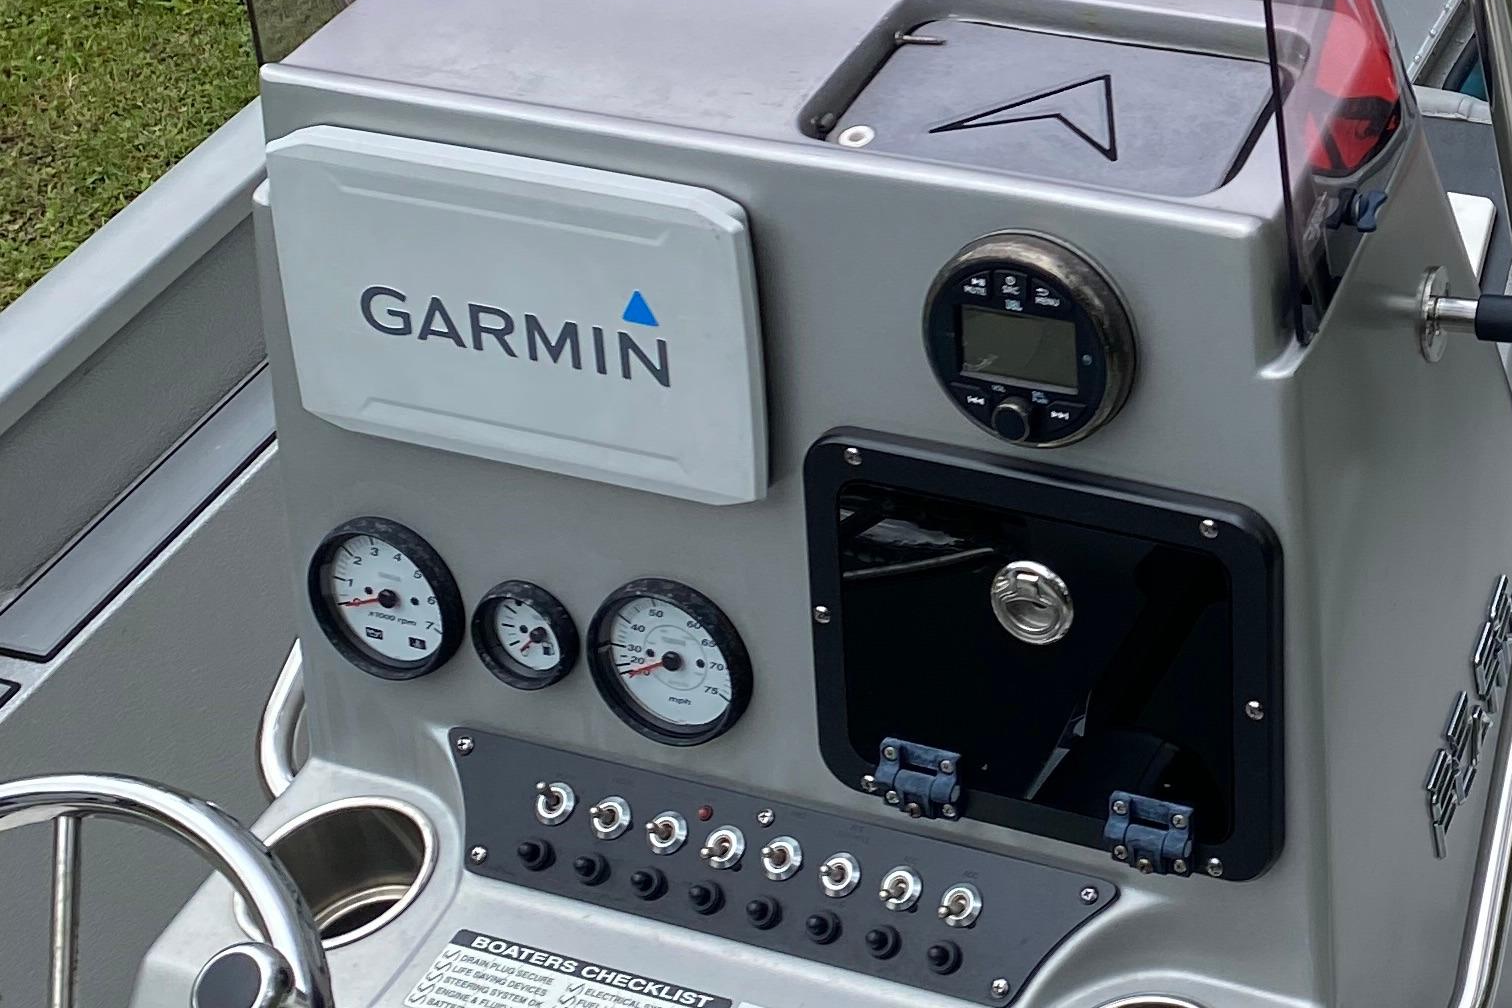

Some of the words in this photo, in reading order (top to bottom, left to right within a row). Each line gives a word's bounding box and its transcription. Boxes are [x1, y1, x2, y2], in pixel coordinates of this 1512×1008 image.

[359, 285, 673, 388] GARMIN
[370, 547, 379, 557] 3
[353, 556, 362, 565] 2
[393, 553, 402, 562] 4
[427, 596, 436, 605] 6
[648, 609, 664, 618] 50
[425, 621, 434, 630] 7
[630, 625, 645, 633] 40
[686, 620, 701, 630] 60
[627, 644, 642, 653] 30
[630, 656, 645, 665] 20
[709, 662, 724, 671] 70
[704, 685, 719, 695] 75
[668, 696, 692, 706] mph
[471, 936, 578, 973] BOATERS
[581, 966, 714, 1008] CHECKLIST
